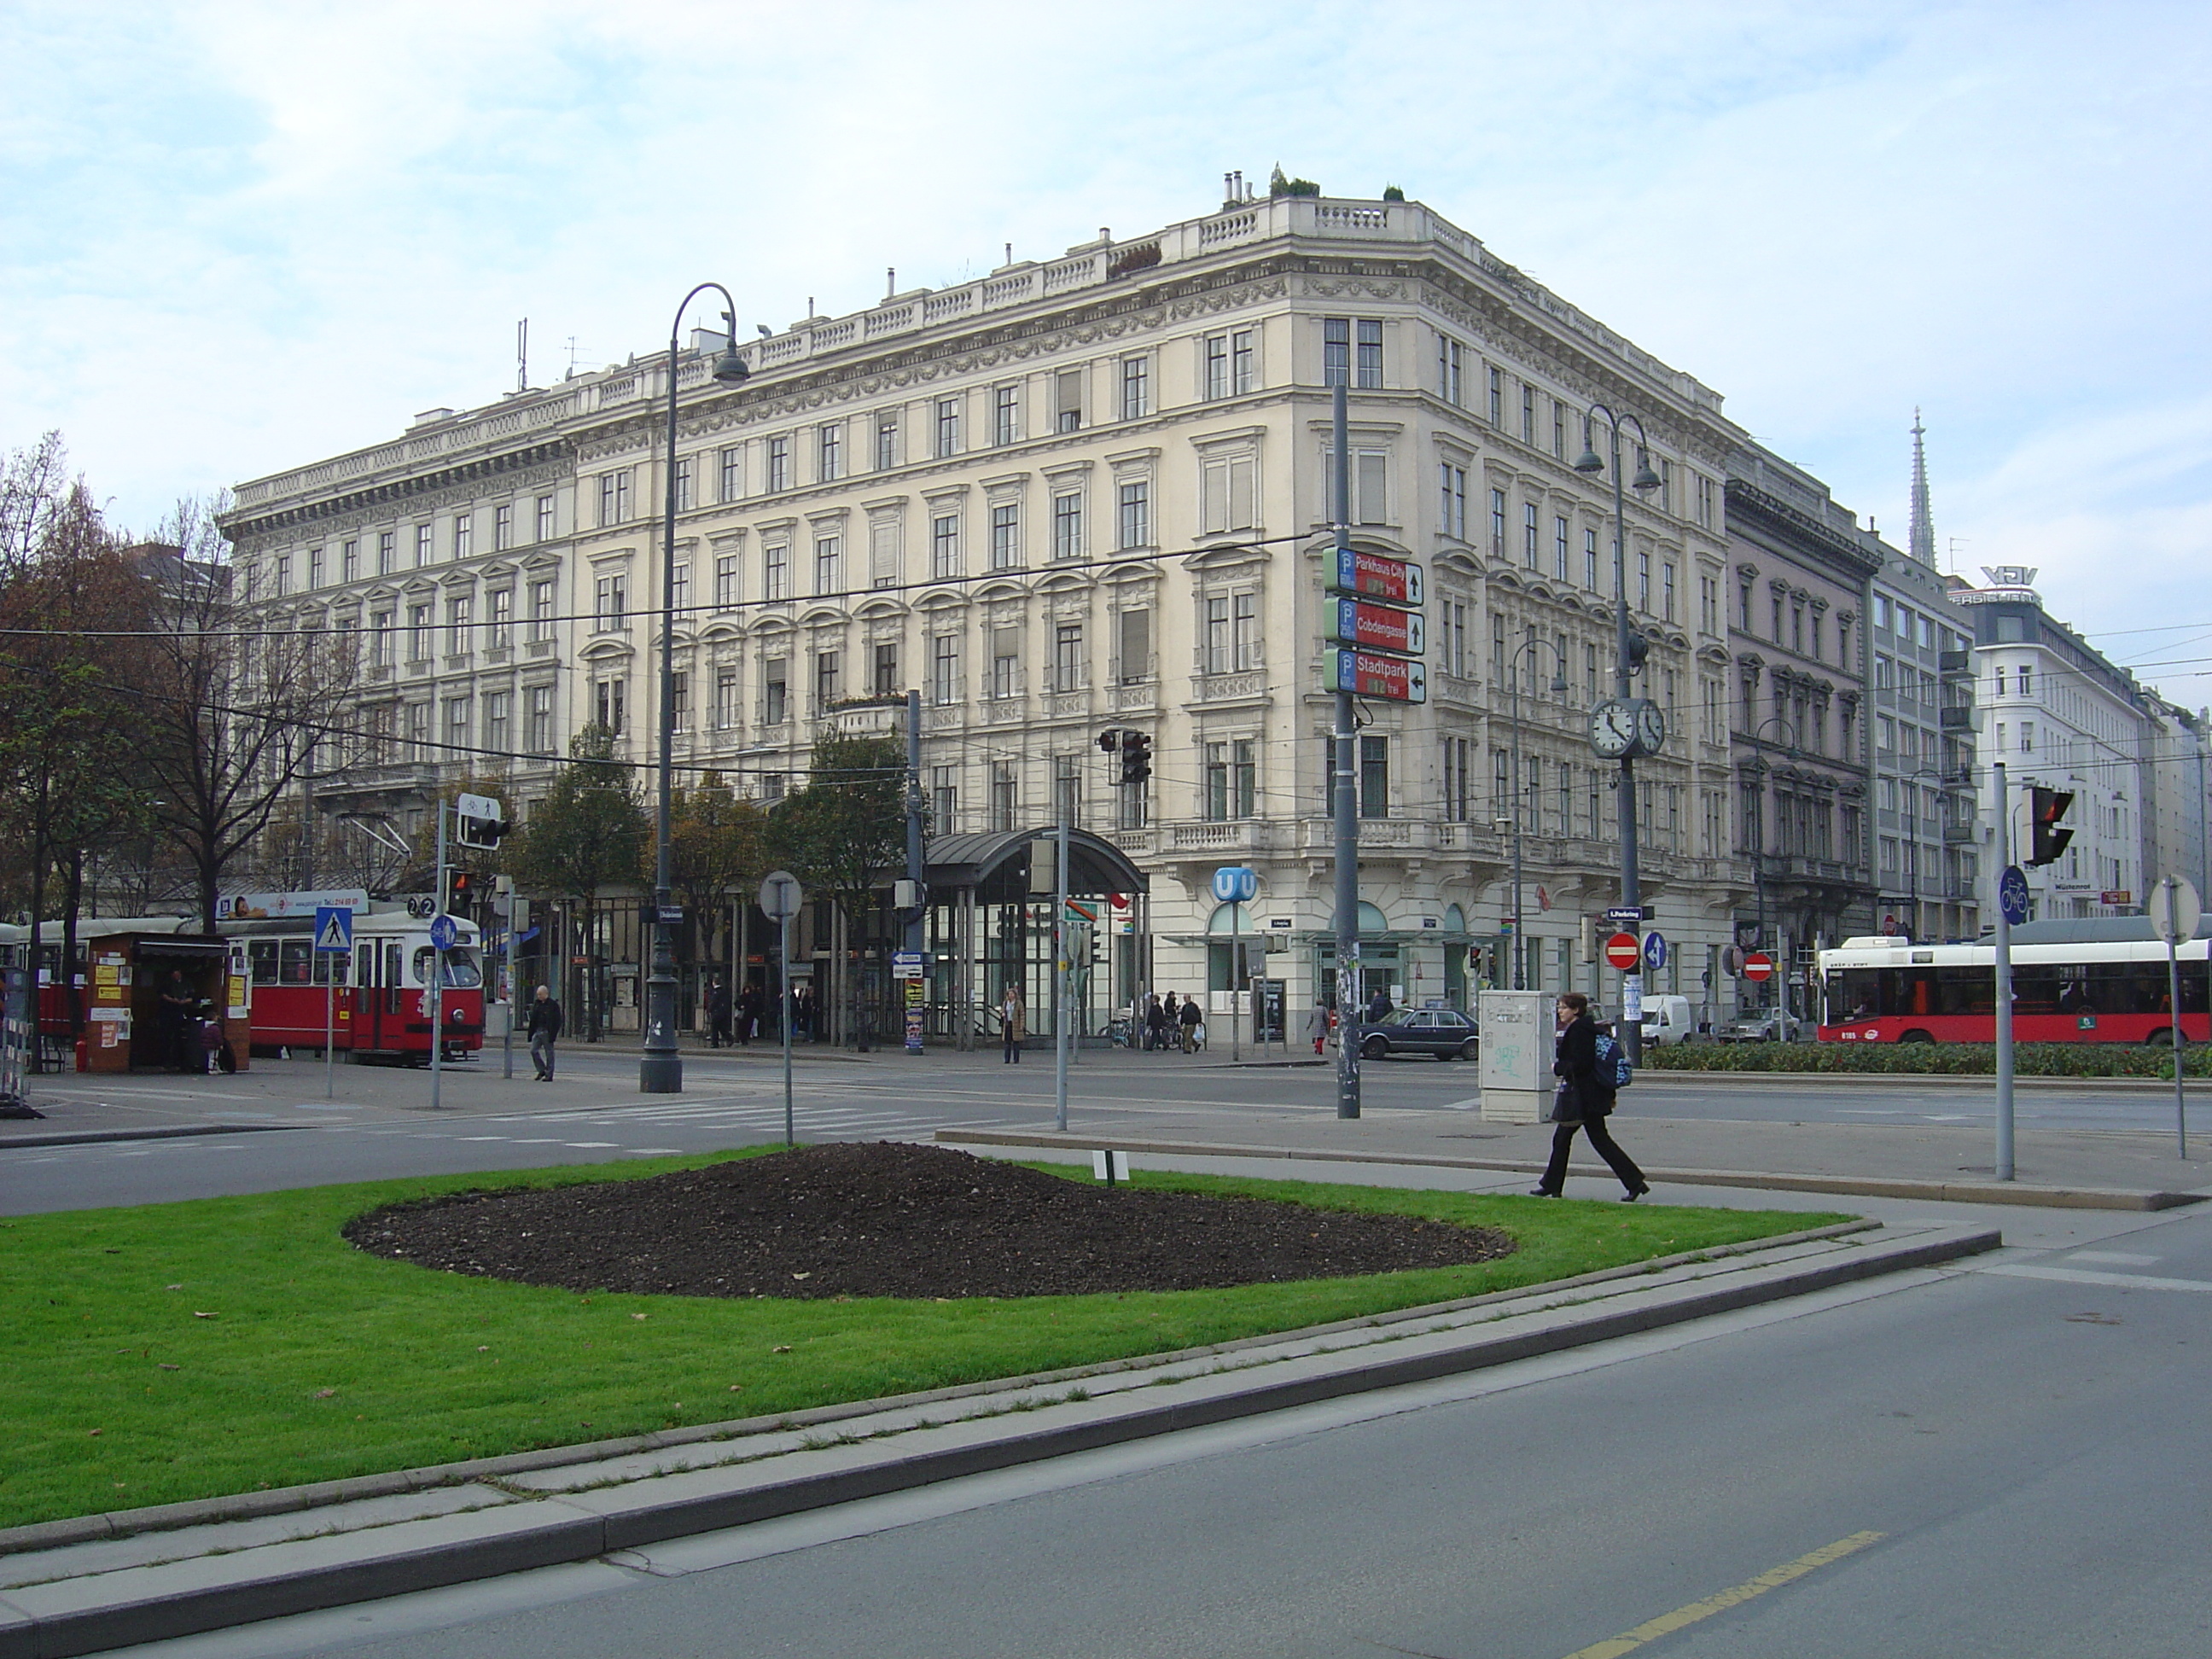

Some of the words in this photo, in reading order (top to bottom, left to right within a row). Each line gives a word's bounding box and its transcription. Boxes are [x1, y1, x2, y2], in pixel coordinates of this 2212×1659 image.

[1343, 556, 1351, 573] P
[1356, 556, 1390, 575] Parkhaus
[1391, 564, 1406, 581] City
[1386, 584, 1397, 596] frei
[1344, 608, 1352, 623] P
[1357, 617, 1406, 638] Cobdengasse
[1343, 659, 1352, 674] P
[1357, 656, 1407, 678] Stadtpark
[1388, 683, 1399, 695] frei
[1216, 874, 1233, 897] U
[1242, 874, 1254, 897] U
[410, 900, 416, 914] 2
[424, 899, 432, 914] 2
